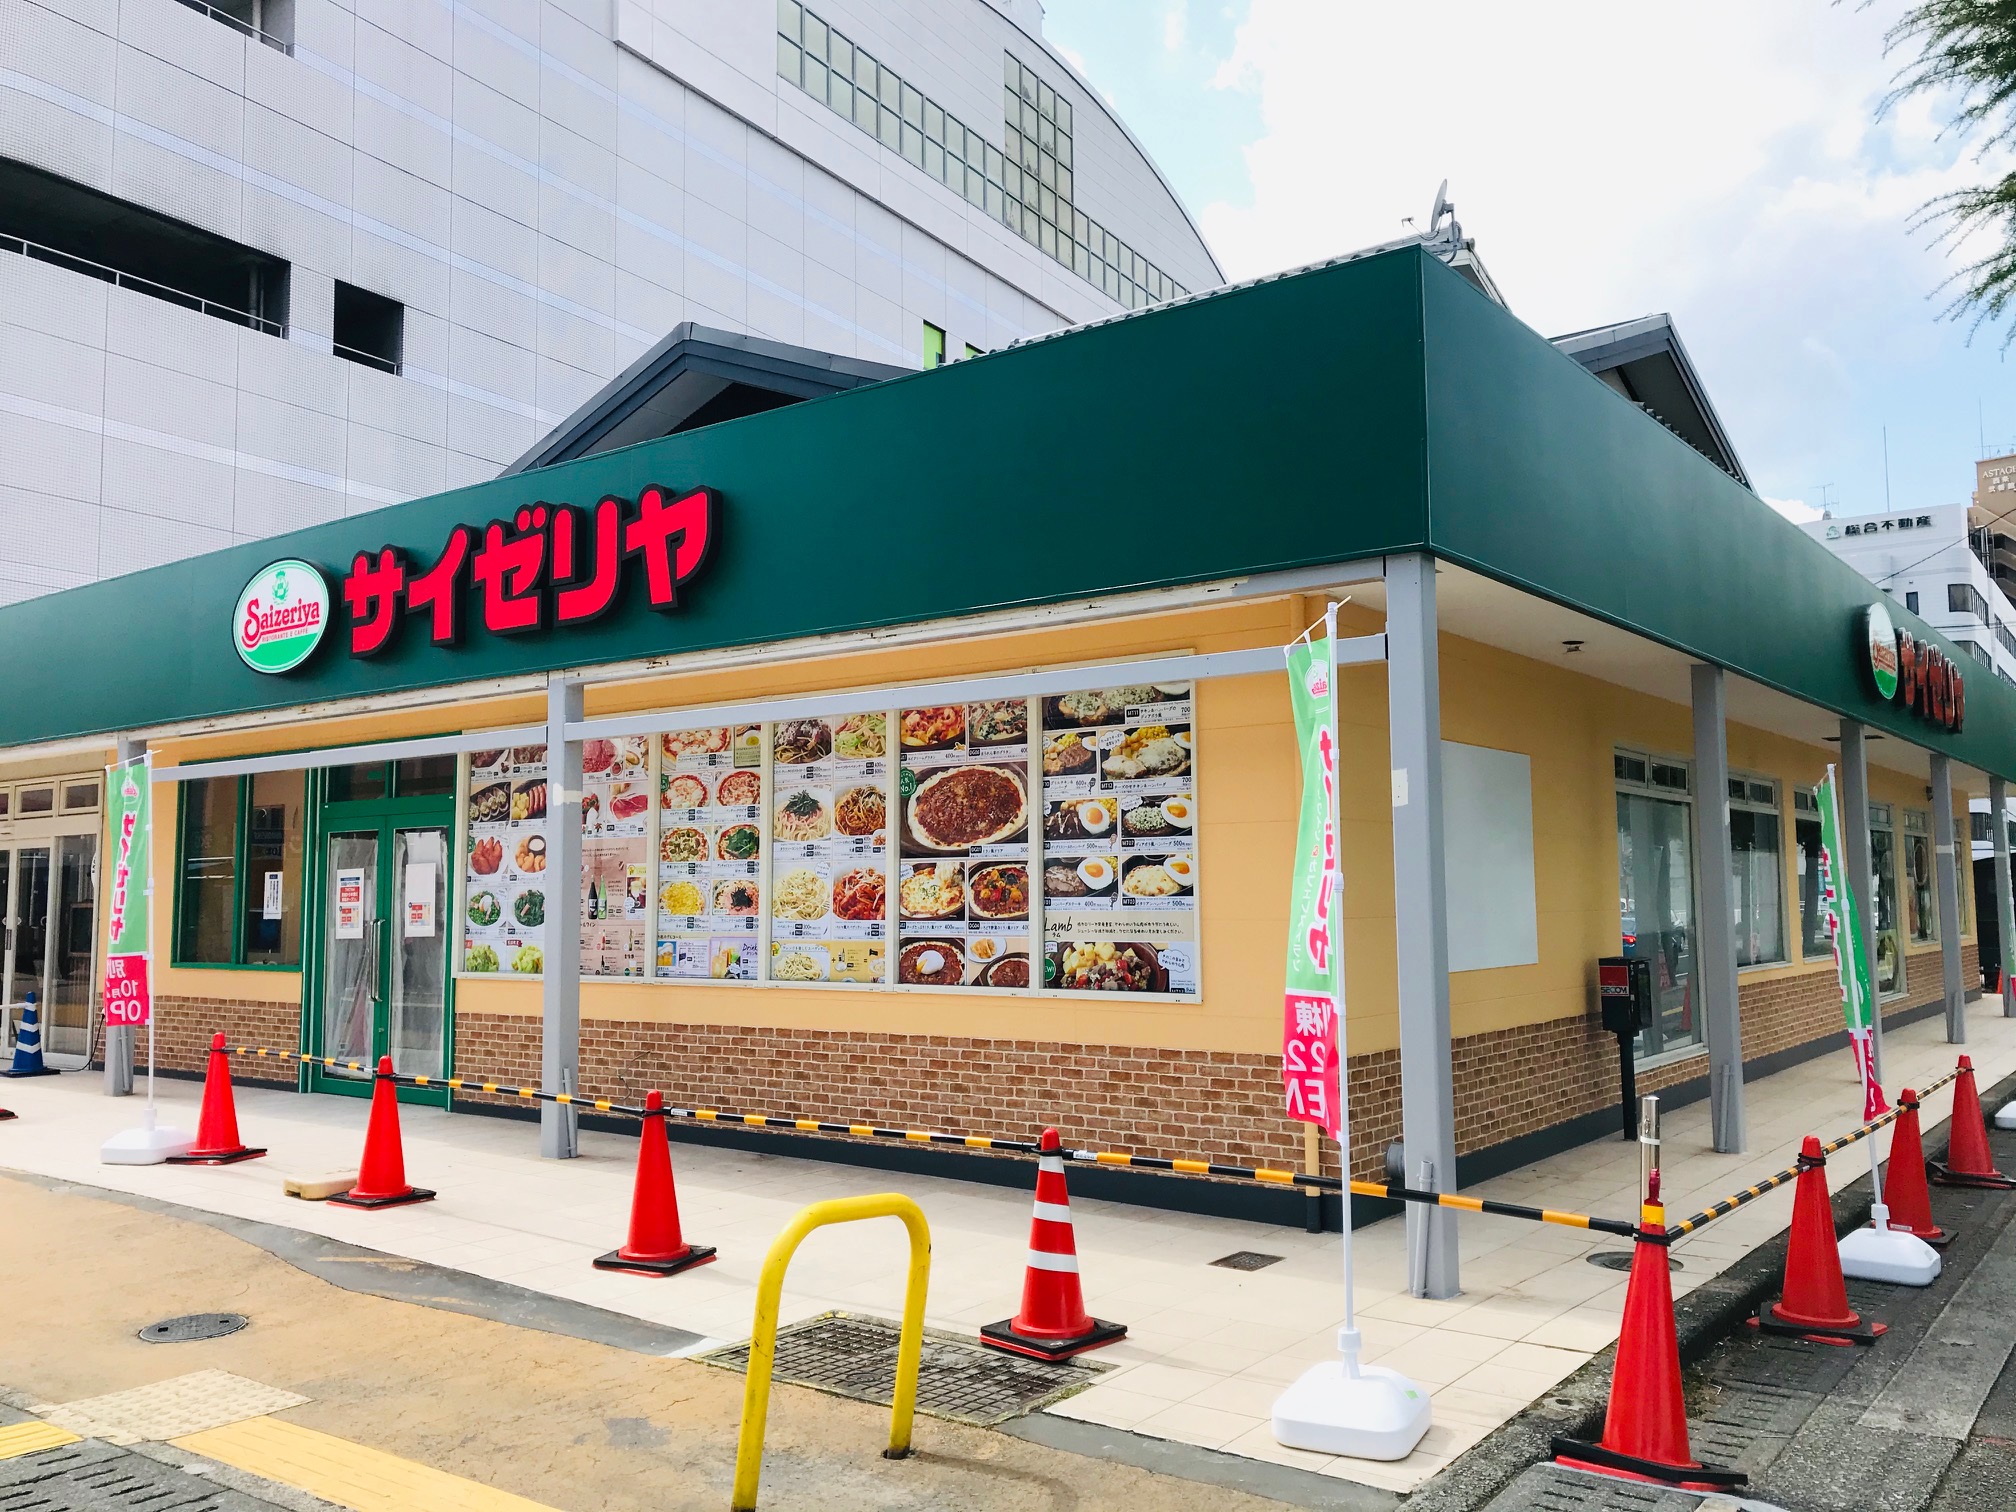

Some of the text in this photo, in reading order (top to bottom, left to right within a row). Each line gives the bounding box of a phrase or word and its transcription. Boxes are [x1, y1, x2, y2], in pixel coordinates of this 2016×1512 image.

[1844, 515, 1932, 537] 総合不動産
[342, 487, 710, 656] サイゼリヤ
[242, 598, 320, 645] Saizeriya
[1045, 916, 1073, 932] Lamb
[1601, 986, 1628, 994] SECOM
